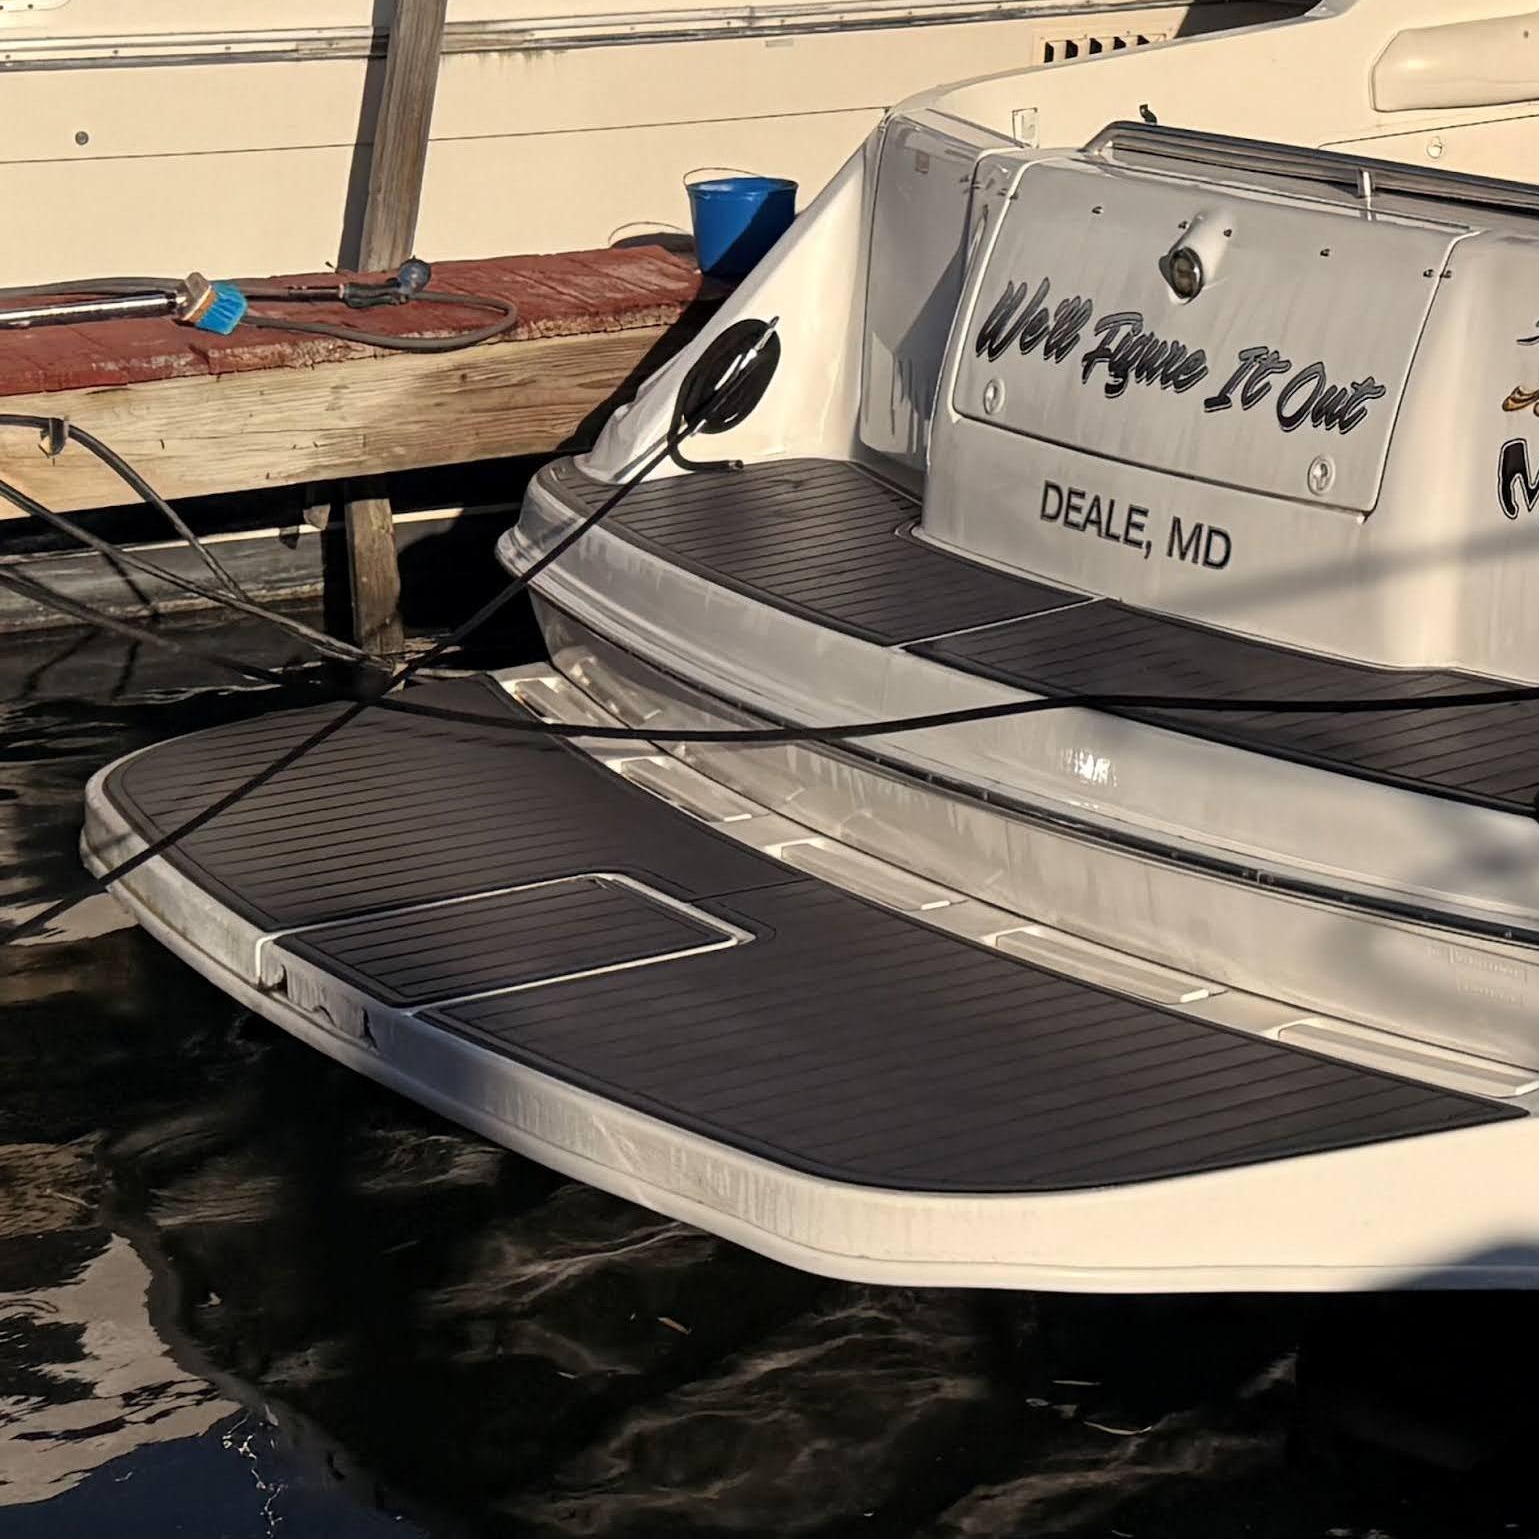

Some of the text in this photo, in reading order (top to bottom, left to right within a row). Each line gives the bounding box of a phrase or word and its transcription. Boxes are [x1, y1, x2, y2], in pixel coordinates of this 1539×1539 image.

[1081, 311, 1209, 398] Figure
[1203, 346, 1292, 413] It
[1276, 361, 1387, 435] Out
[1039, 479, 1232, 570] DEALE, MD
